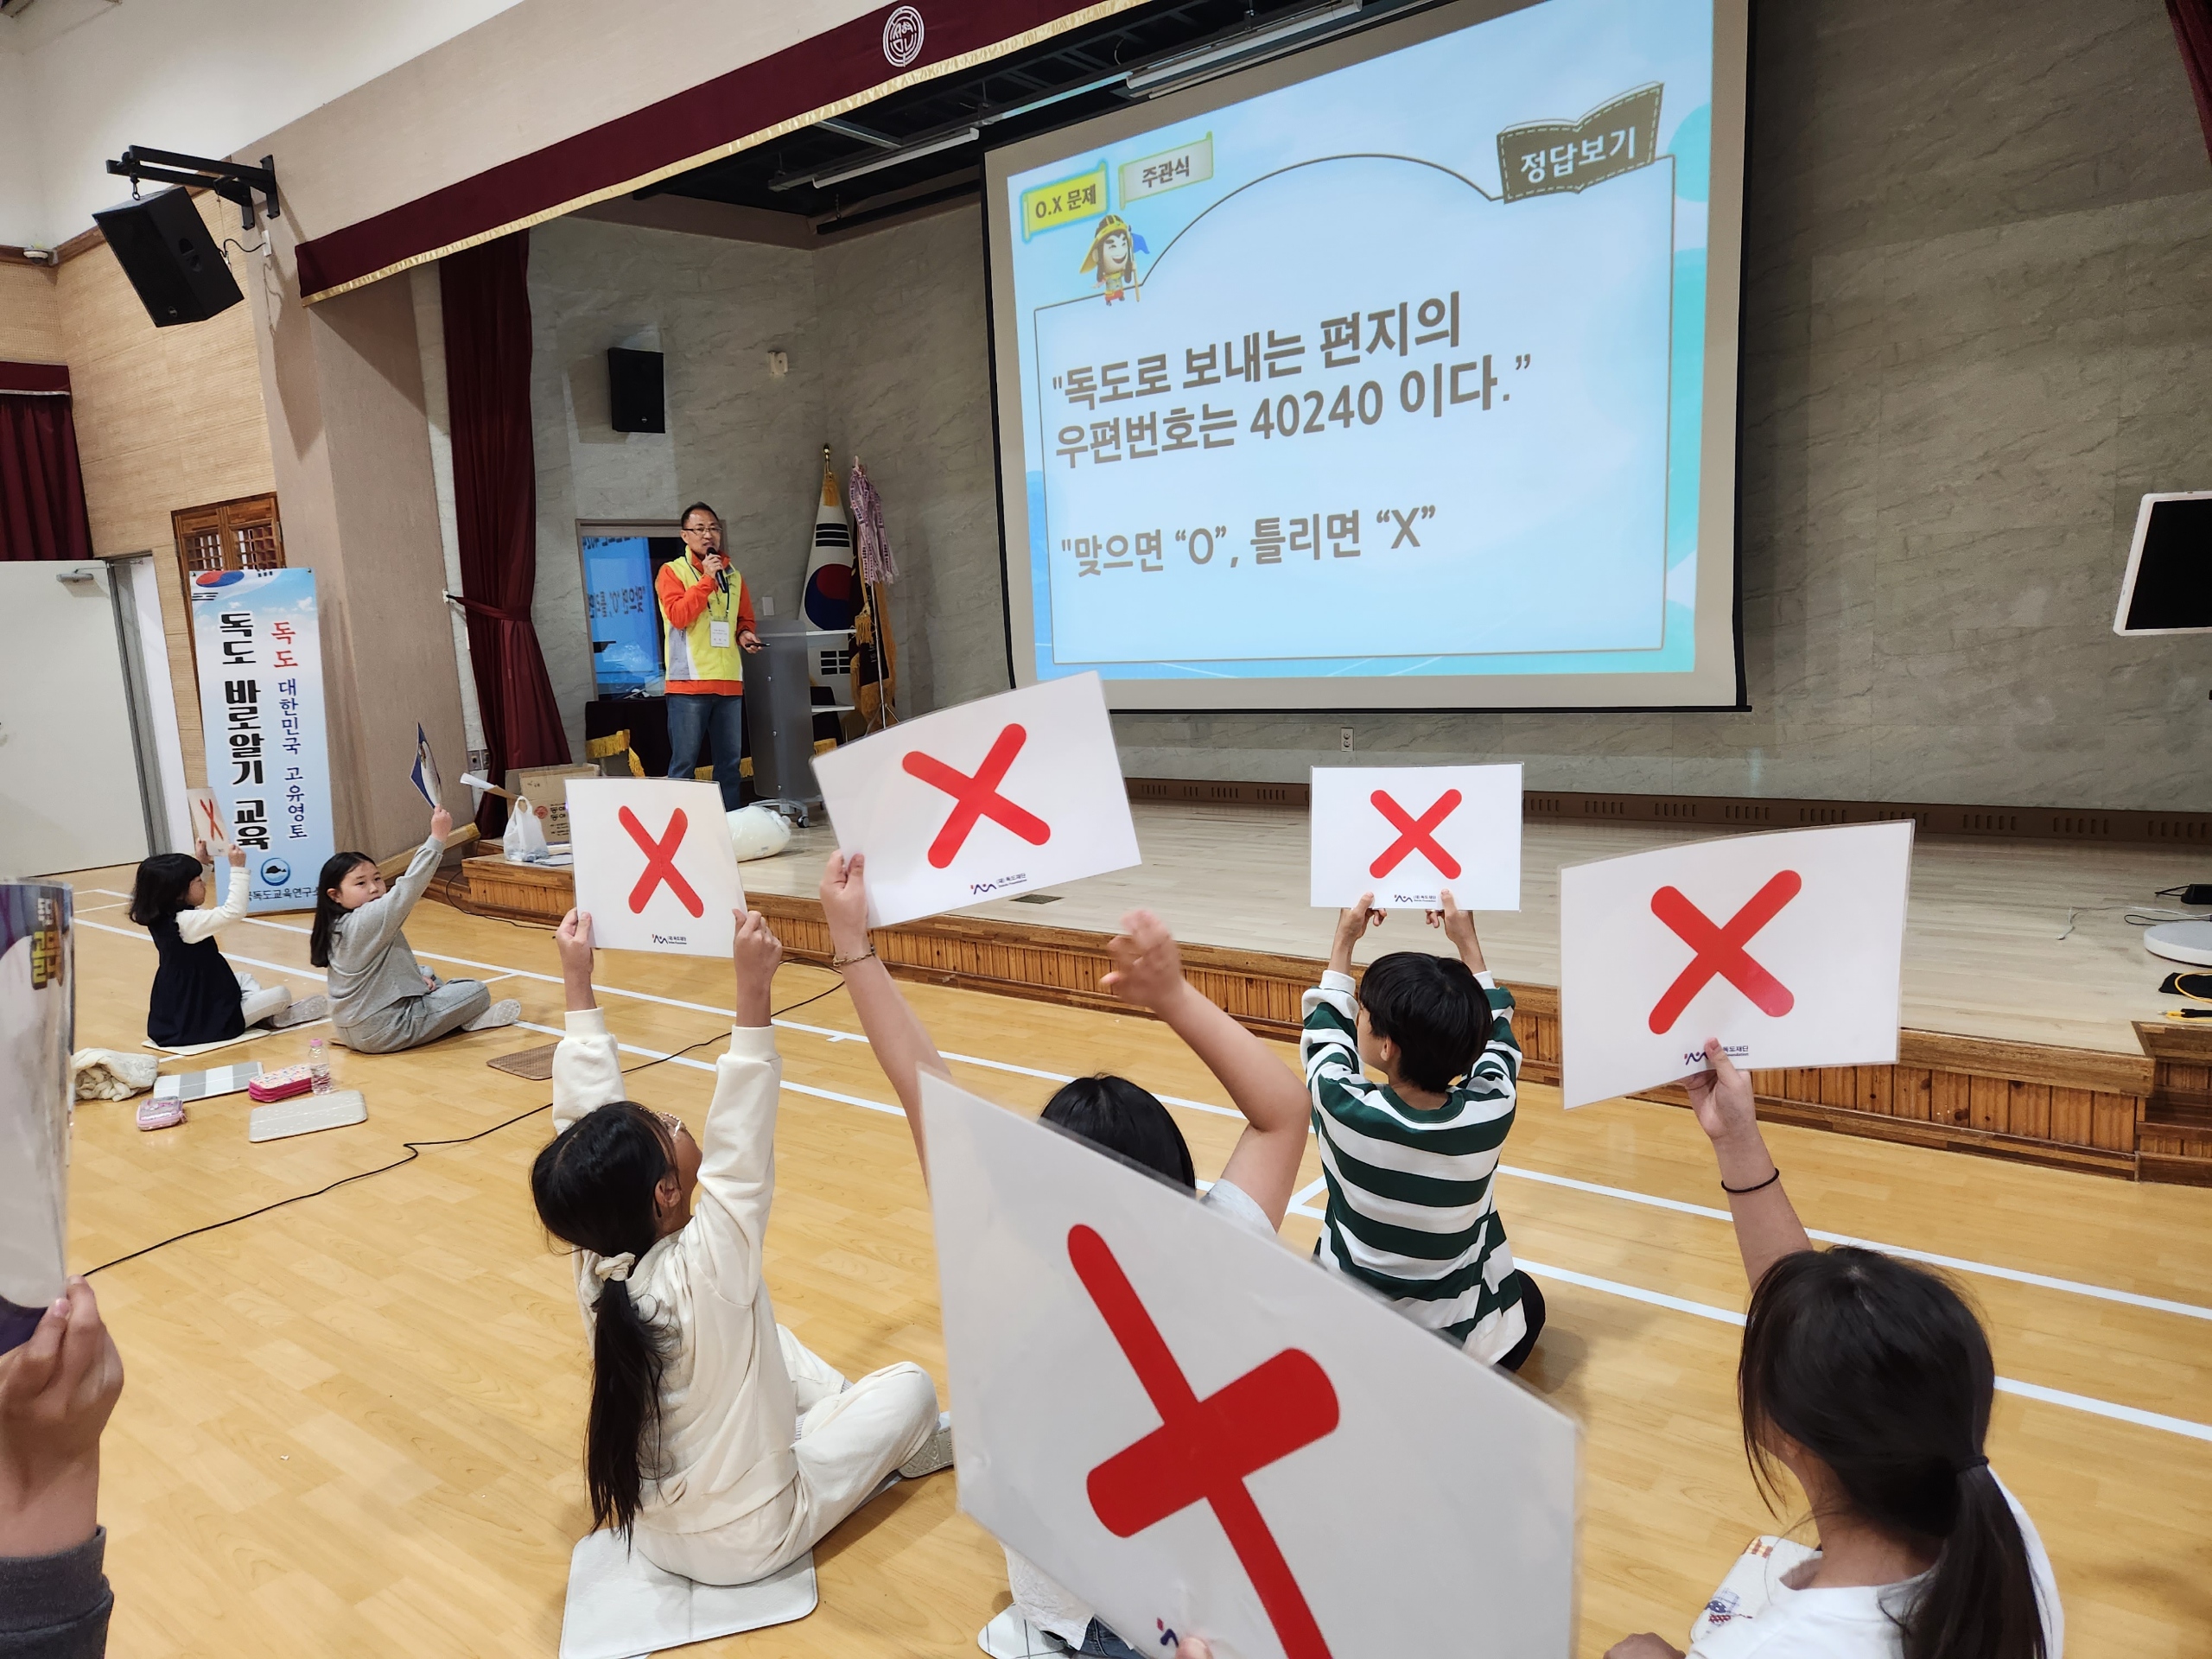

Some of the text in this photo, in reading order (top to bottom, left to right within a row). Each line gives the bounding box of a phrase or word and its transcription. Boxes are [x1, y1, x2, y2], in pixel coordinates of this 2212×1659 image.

[1141, 156, 1190, 188] 주관식
[1521, 126, 1636, 183] 정답보기
[1035, 183, 1096, 219] O.X 문제
[1182, 330, 1306, 390] 보내는
[1319, 290, 1460, 370] 편지의
[1056, 403, 1238, 469] 우편번호는
[1249, 380, 1383, 440] 40240
[1249, 509, 1362, 566] 틀리면
[219, 613, 270, 850] 독도 바로알기 교육
[270, 621, 308, 840] 독도 대한민국 고유영토
